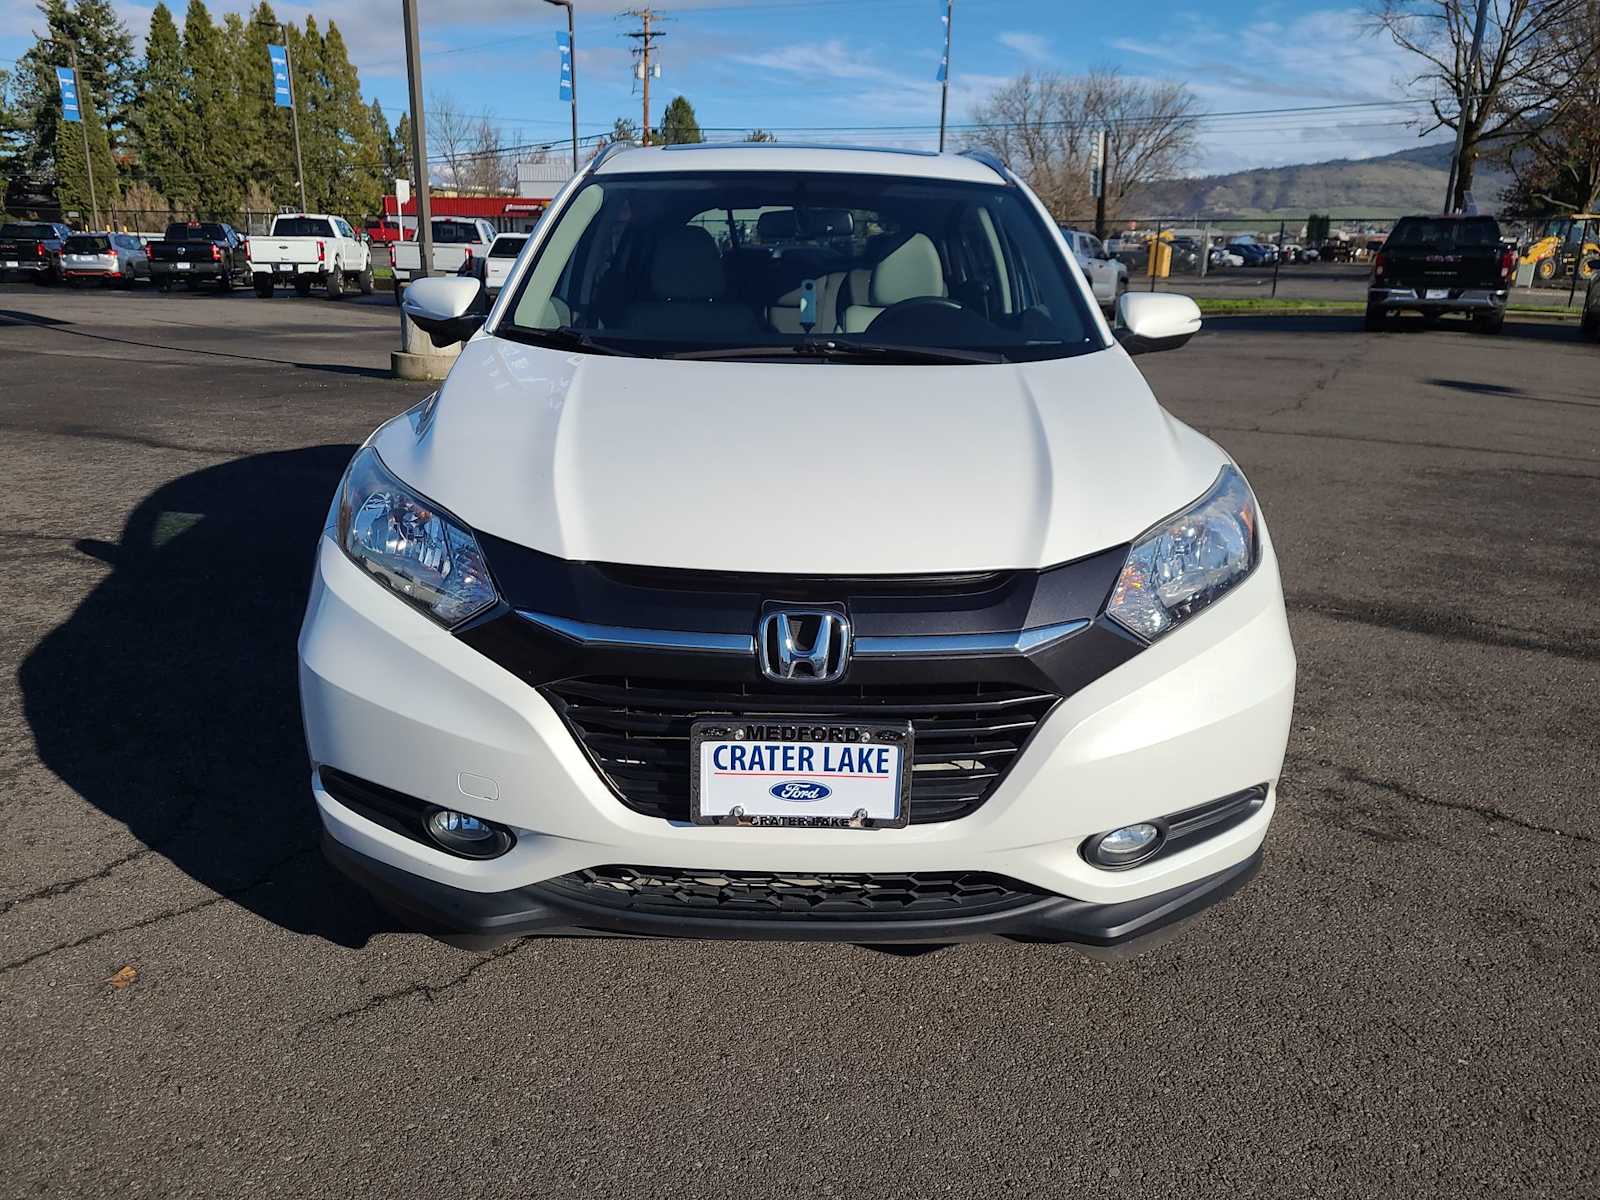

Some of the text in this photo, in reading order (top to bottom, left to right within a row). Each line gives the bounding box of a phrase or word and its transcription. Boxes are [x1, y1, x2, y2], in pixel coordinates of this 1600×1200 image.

[746, 725, 860, 741] MEDFORD
[713, 744, 889, 774] CRATER LAKE
